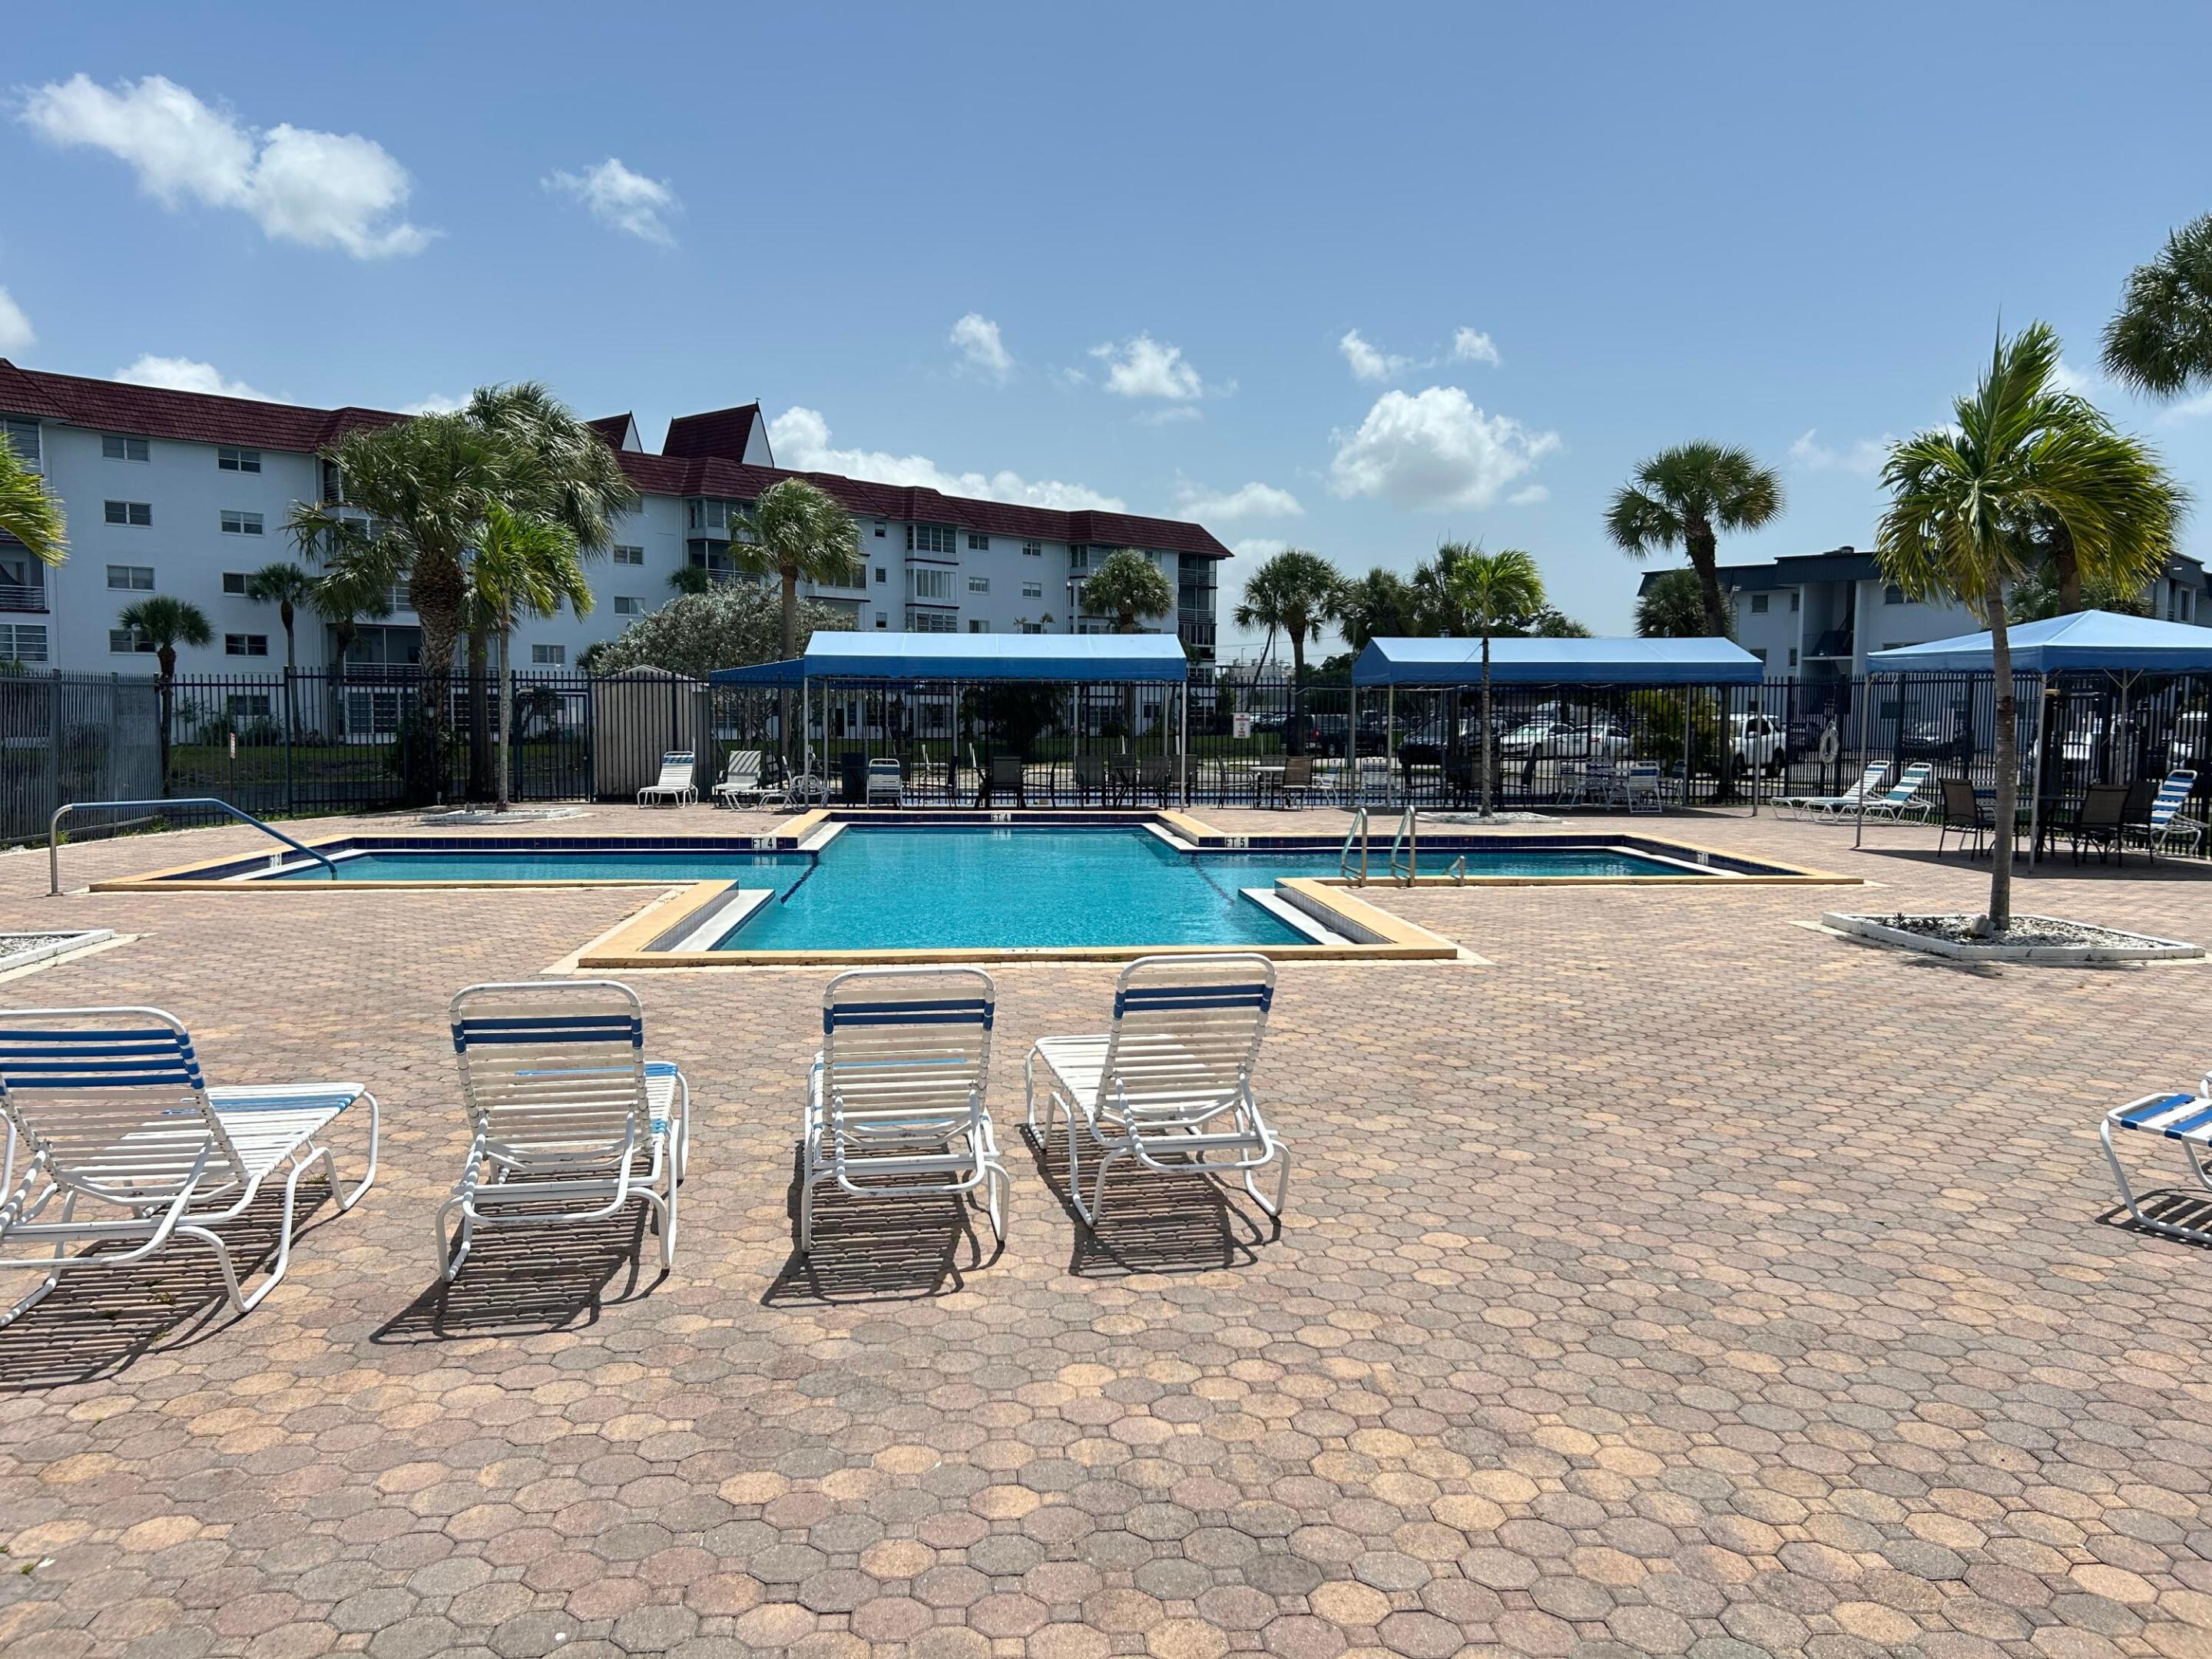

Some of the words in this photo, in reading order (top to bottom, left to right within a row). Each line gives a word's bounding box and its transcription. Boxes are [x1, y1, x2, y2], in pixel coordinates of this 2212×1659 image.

[753, 838, 764, 849] FT
[767, 838, 773, 849] 4
[1226, 837, 1237, 848] FT
[1240, 837, 1245, 848] 5
